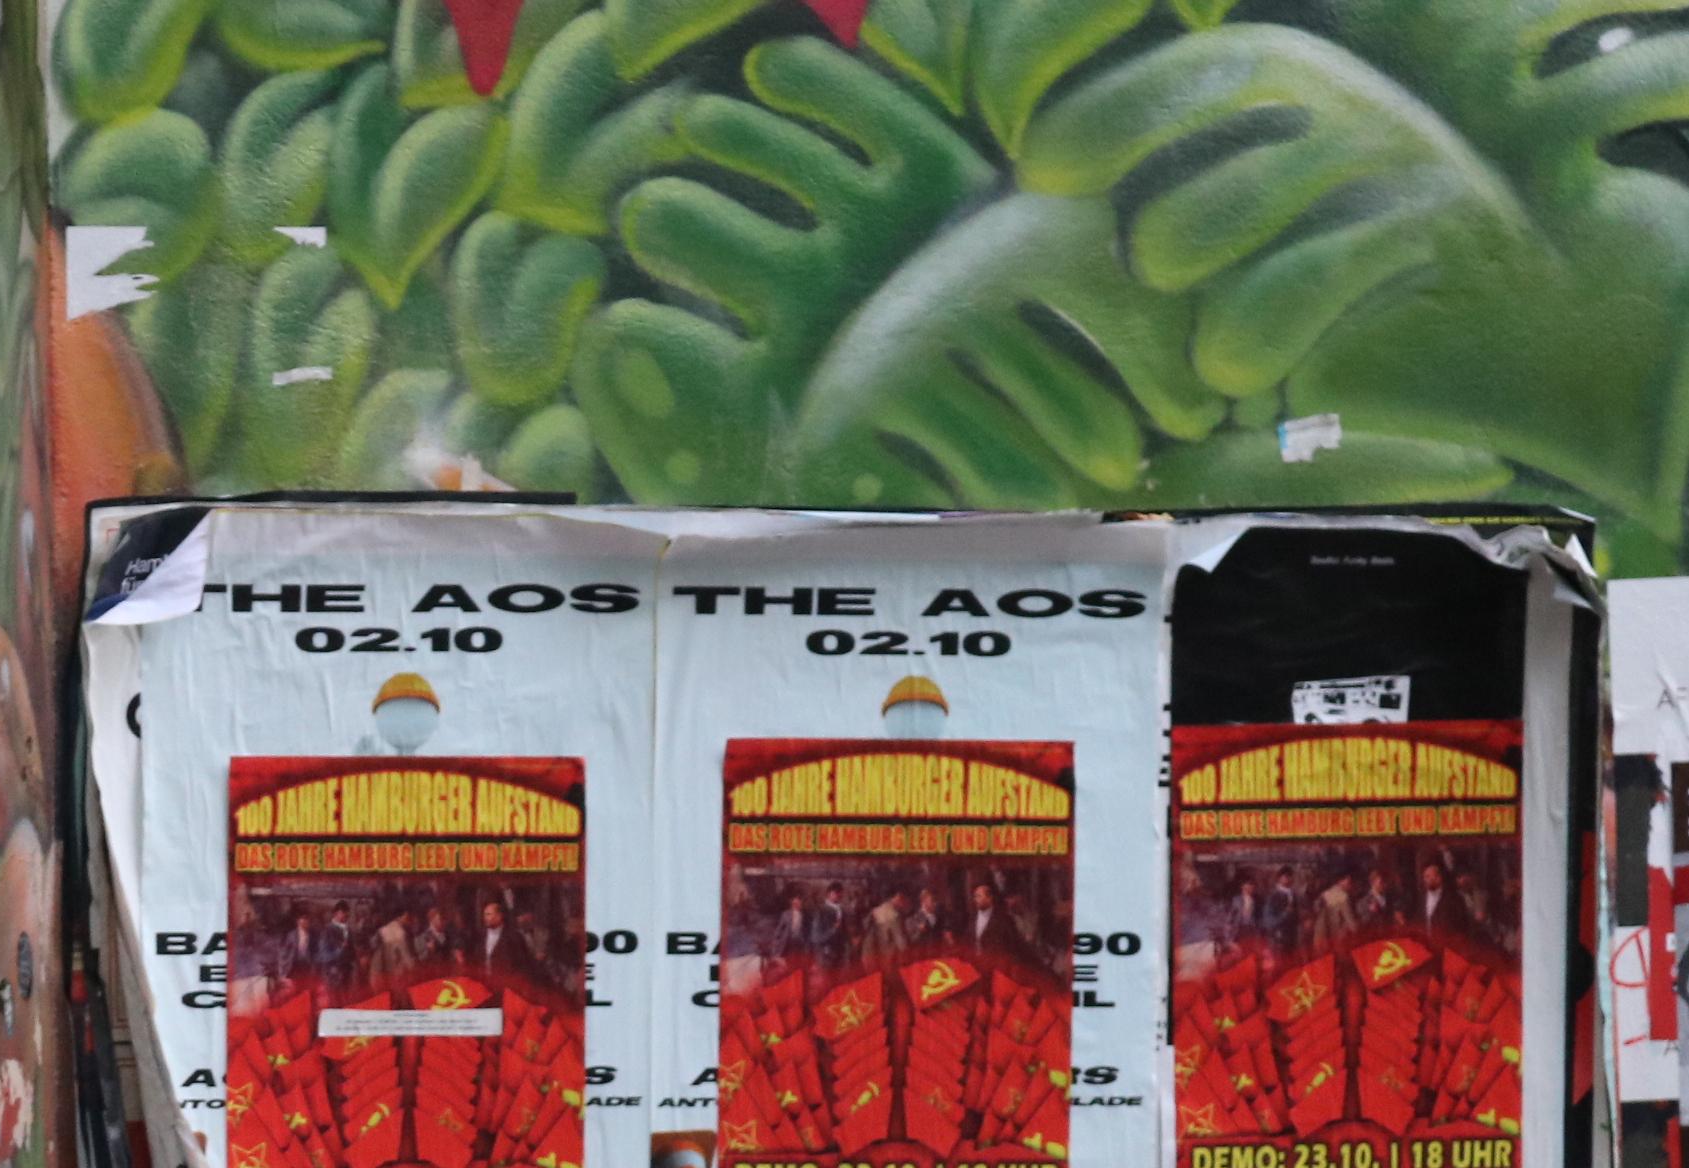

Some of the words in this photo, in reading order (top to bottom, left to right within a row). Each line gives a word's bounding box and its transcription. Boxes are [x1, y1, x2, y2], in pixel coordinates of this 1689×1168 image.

[194, 584, 365, 613] THE
[411, 583, 640, 614] AOS
[673, 585, 877, 616] THE
[921, 588, 1147, 619] AOS
[295, 626, 503, 654] 02.10
[805, 630, 1012, 657] 02.10
[729, 776, 767, 816] 100
[771, 758, 831, 816] JAHRE
[836, 753, 964, 816] HAMBURGER
[968, 760, 1069, 819] AUFSTAND
[1180, 764, 1216, 805] 100
[1220, 745, 1281, 801] JAHRE
[1284, 738, 1411, 800] HAMBURGER
[1415, 742, 1517, 799] AUFSTAND
[236, 795, 272, 835] 100
[277, 776, 338, 834] JAHRE
[342, 770, 472, 834] HAMBURGER
[476, 777, 581, 835] AUFSTAND
[730, 824, 766, 851] DAS
[768, 824, 814, 851] ROTE
[817, 824, 906, 852] HAMBURG
[909, 825, 950, 853] LEBT
[951, 825, 989, 853] UND
[1180, 810, 1217, 839] DAS
[1218, 809, 1264, 837] ROTE
[1266, 808, 1355, 836] HAMBURG
[1357, 807, 1398, 835] LEBT
[1399, 806, 1436, 834] UND
[235, 843, 272, 871] DAS
[274, 843, 320, 871] ROTE
[324, 843, 412, 870] HAMBURG
[415, 843, 456, 871] LEBT
[459, 844, 498, 871] UND
